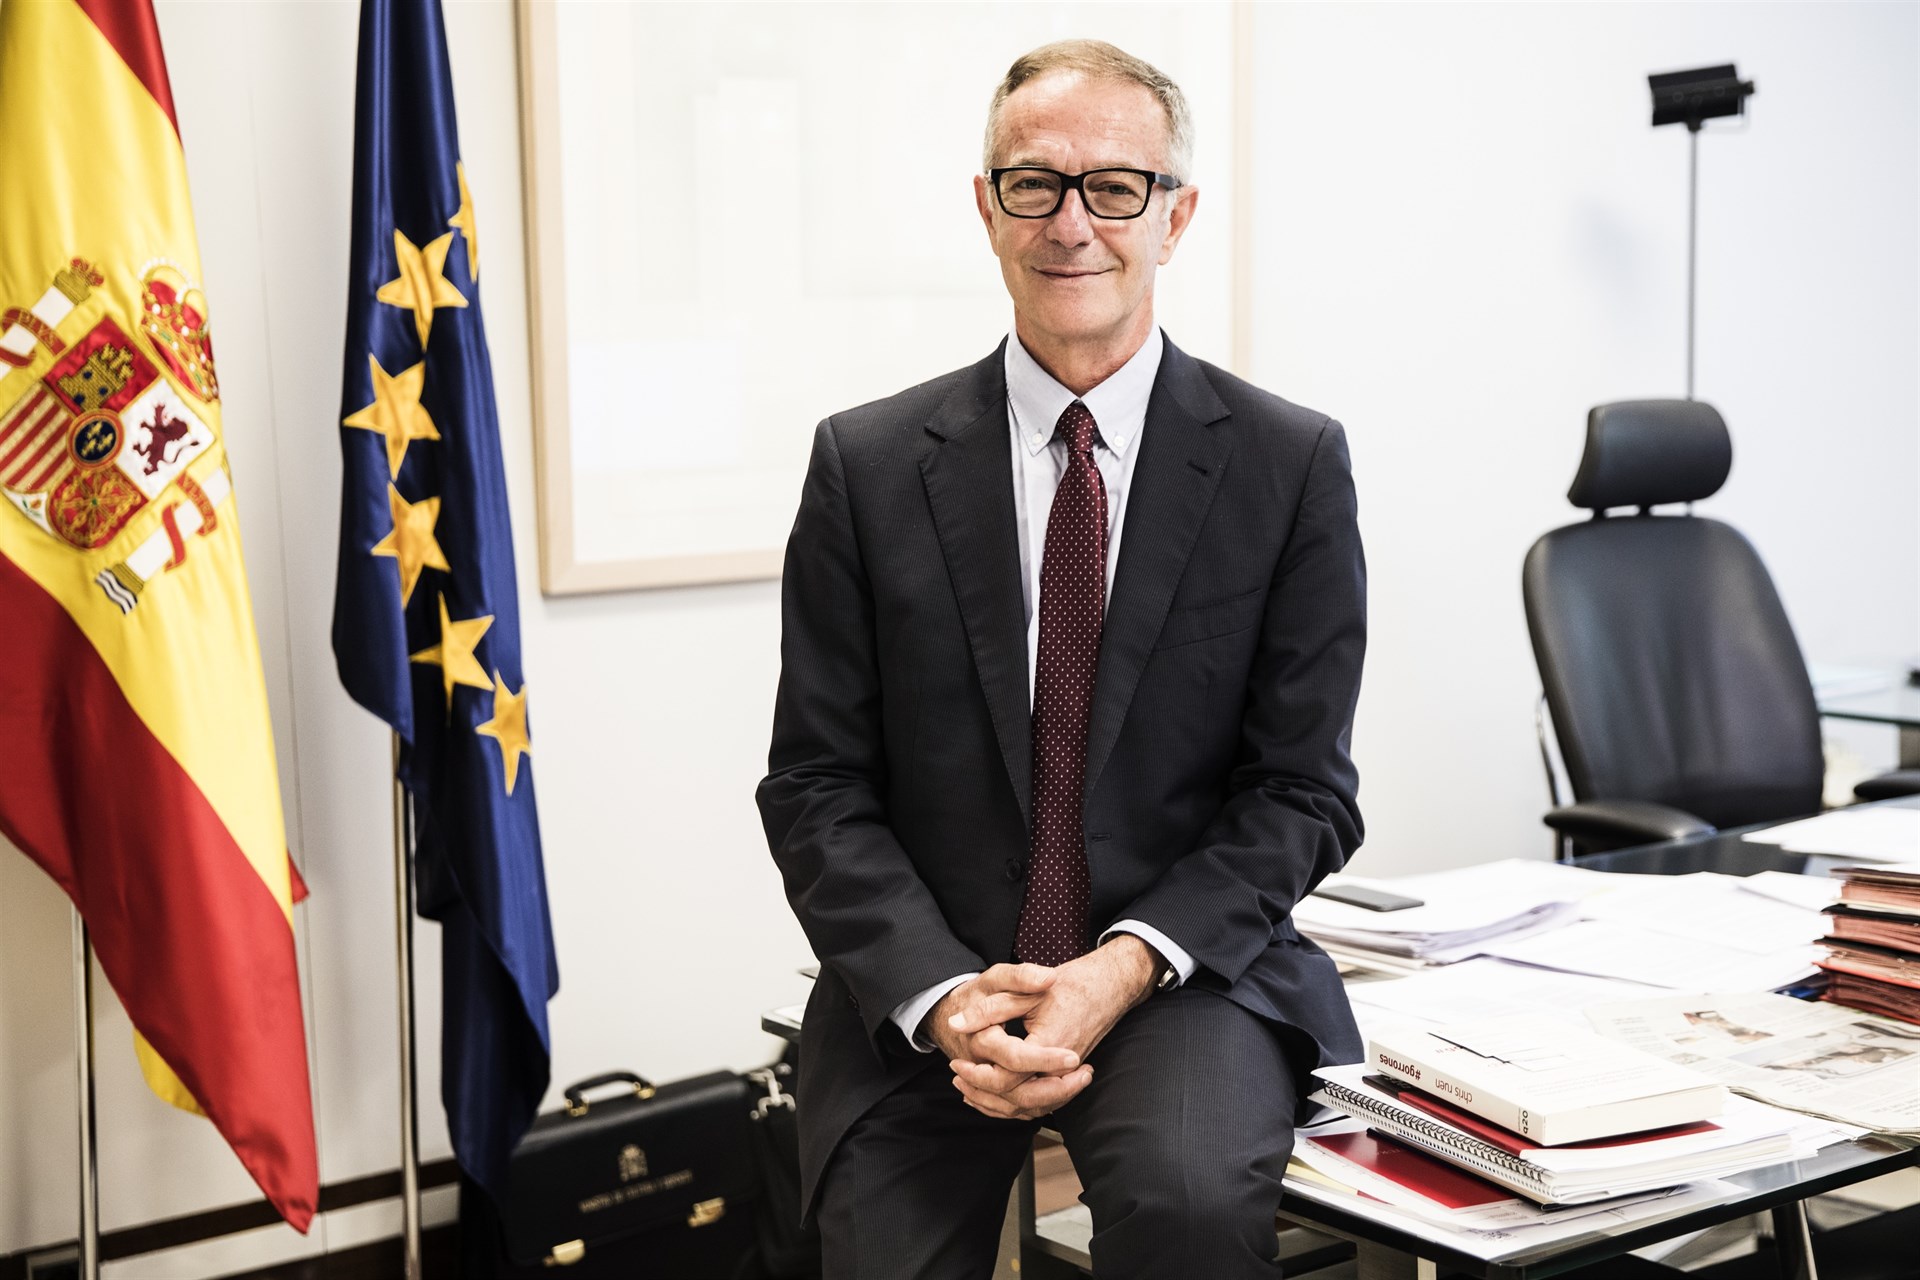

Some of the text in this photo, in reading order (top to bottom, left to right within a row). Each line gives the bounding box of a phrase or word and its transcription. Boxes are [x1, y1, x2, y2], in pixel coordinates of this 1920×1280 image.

[1379, 1053, 1421, 1081] #gorrones
[1435, 1078, 1473, 1105] chris ruen
